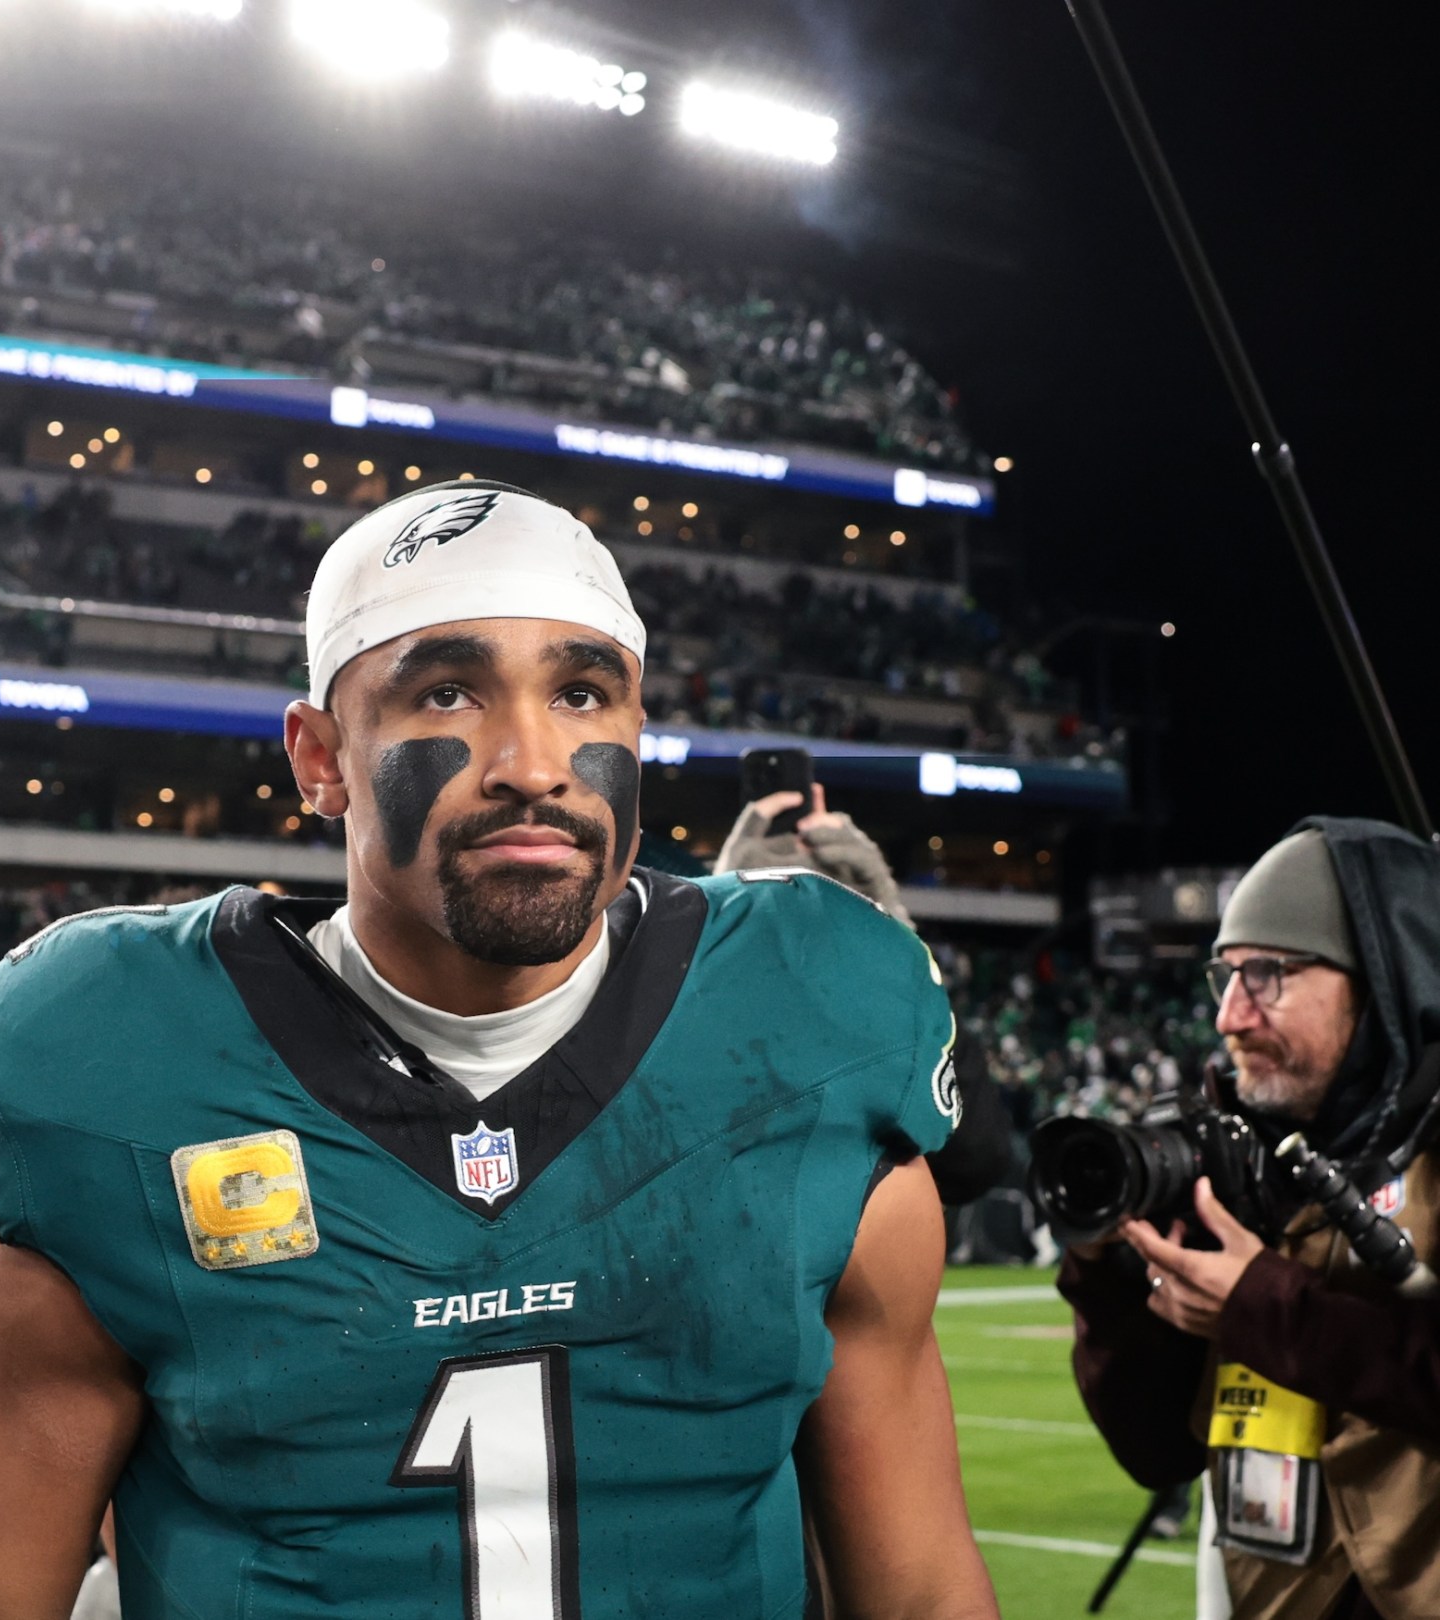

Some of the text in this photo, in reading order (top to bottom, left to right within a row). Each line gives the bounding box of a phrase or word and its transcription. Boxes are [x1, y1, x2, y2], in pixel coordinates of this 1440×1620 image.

[187, 1142, 301, 1238] C
[465, 1158, 509, 1189] NFL
[412, 1280, 577, 1328] EAGLES
[387, 1344, 581, 1620] 1
